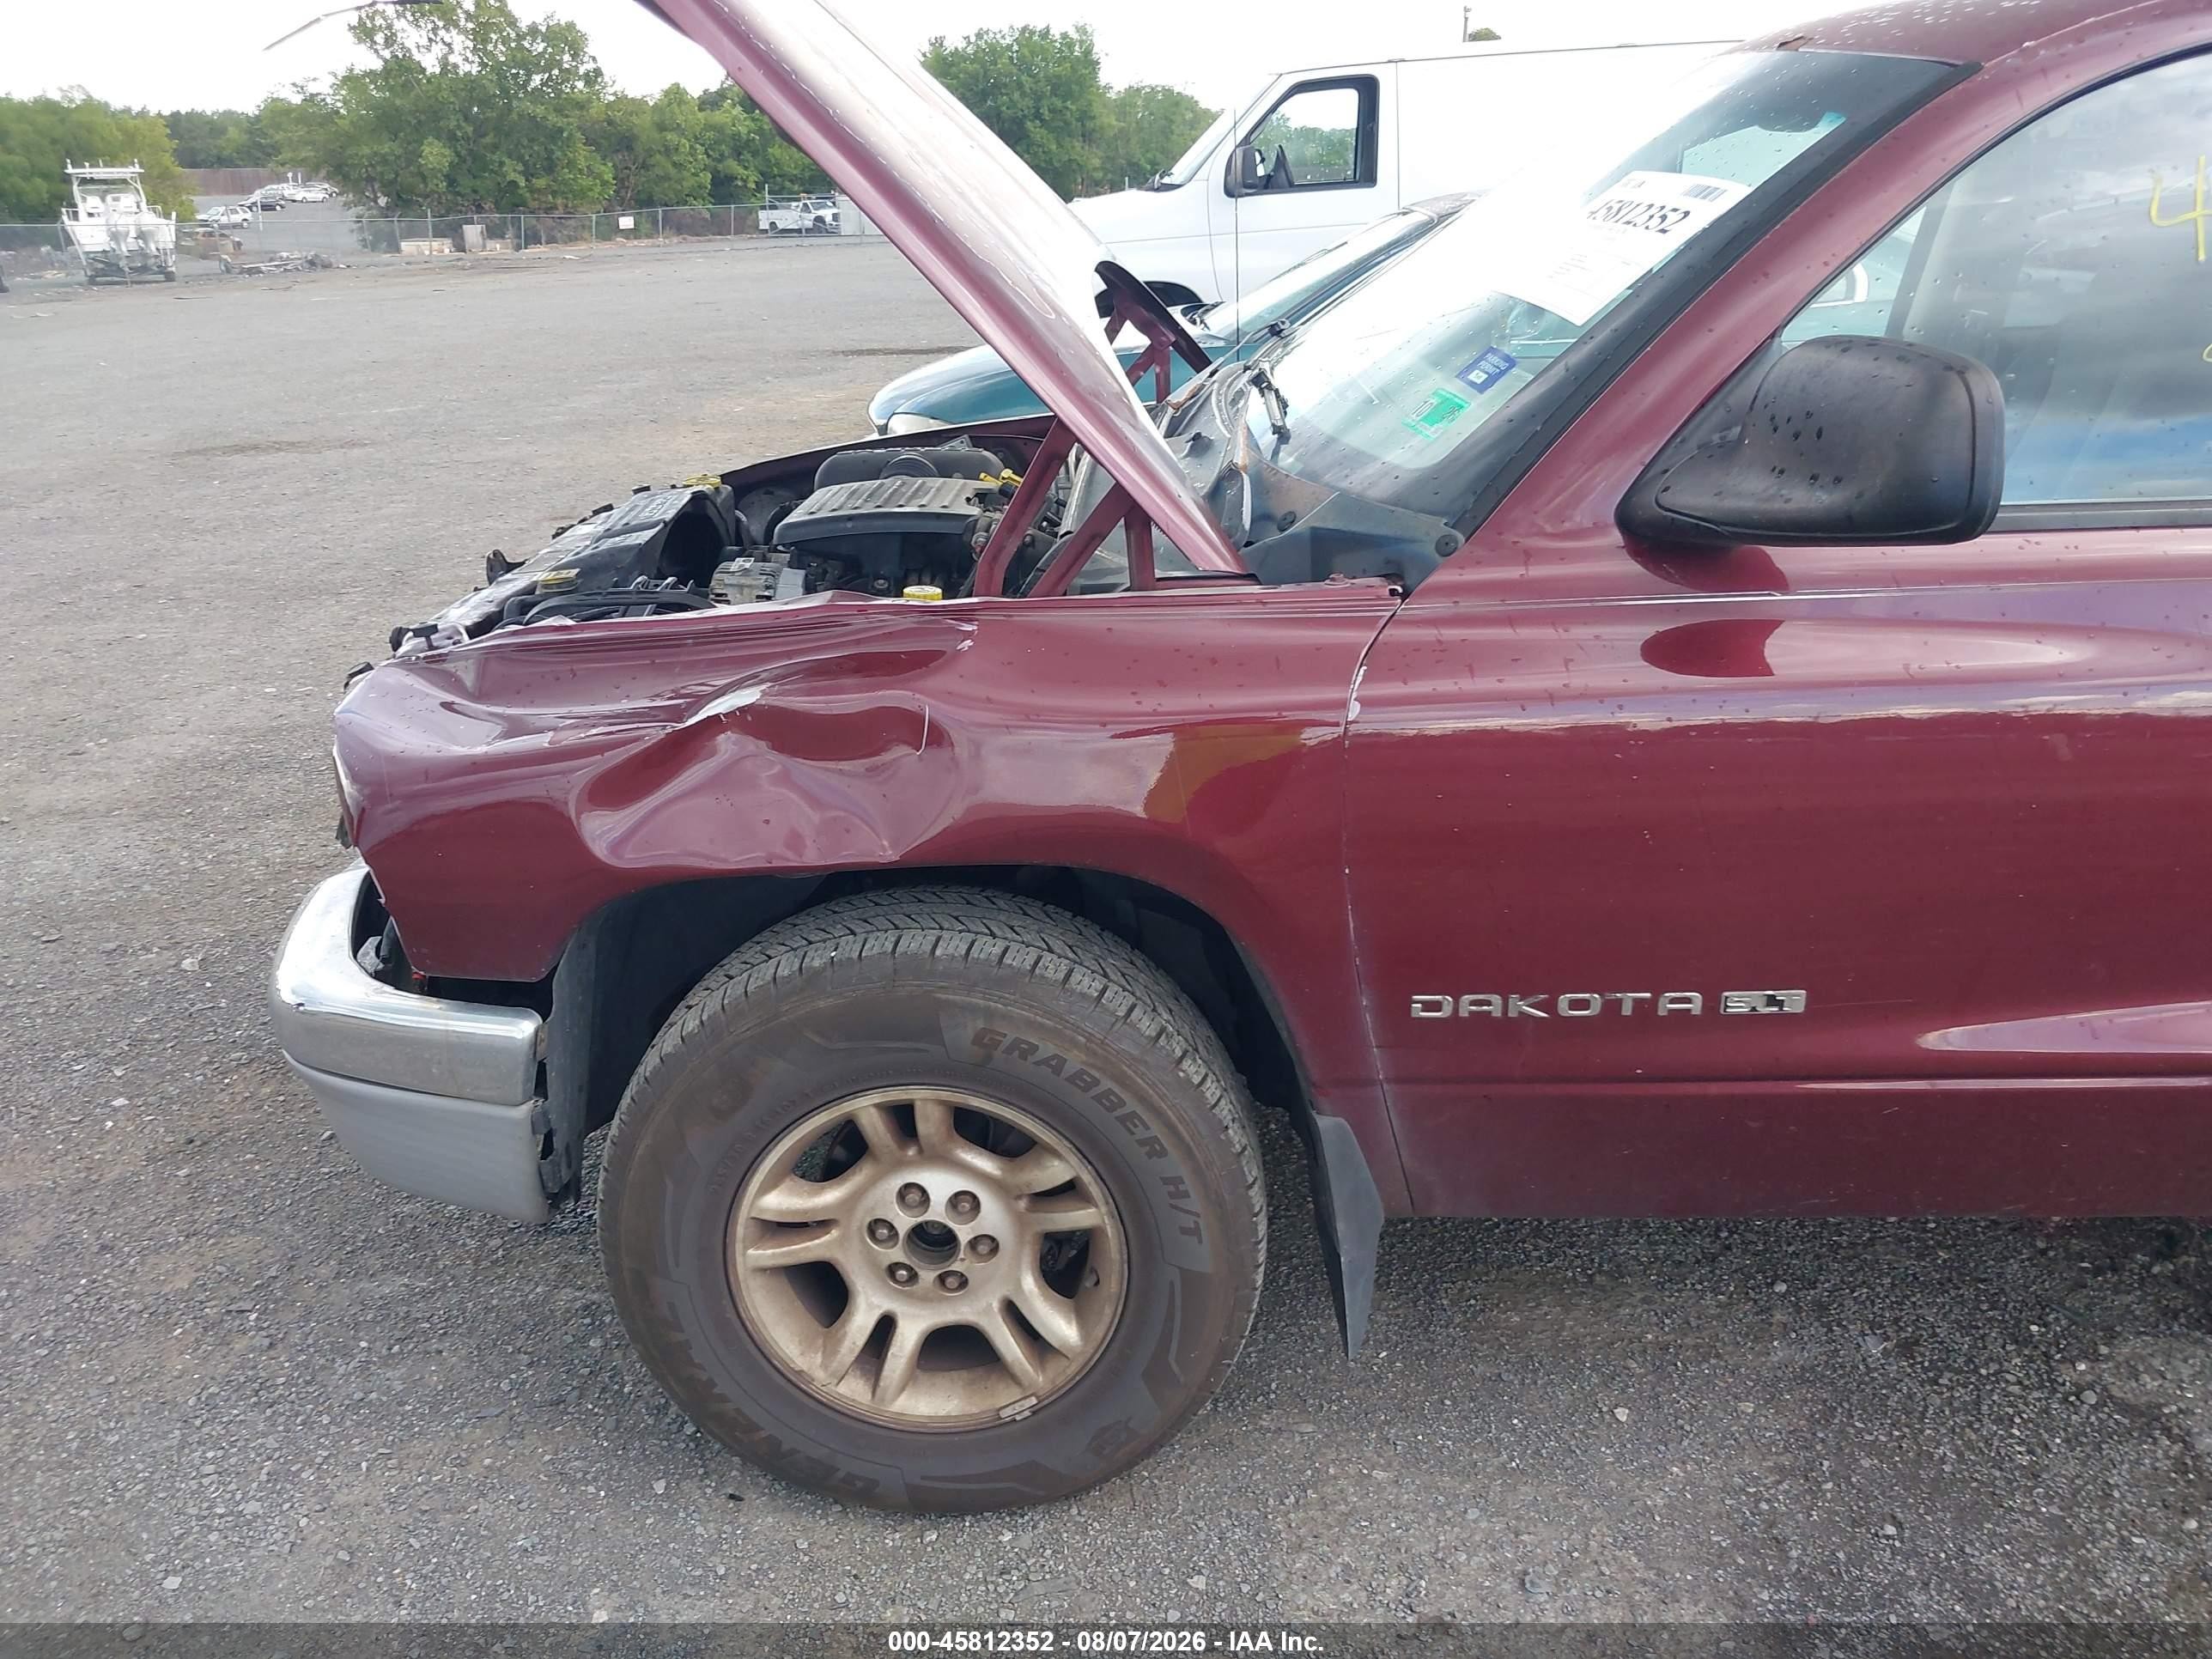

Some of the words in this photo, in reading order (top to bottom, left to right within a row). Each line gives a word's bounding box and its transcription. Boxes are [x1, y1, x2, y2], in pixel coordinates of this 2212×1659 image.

[1411, 993, 1703, 1018] DAKOTA
[1721, 991, 1806, 1014] SLT
[970, 1027, 1169, 1160] GRABBER
[1159, 1176, 1203, 1244] H/T
